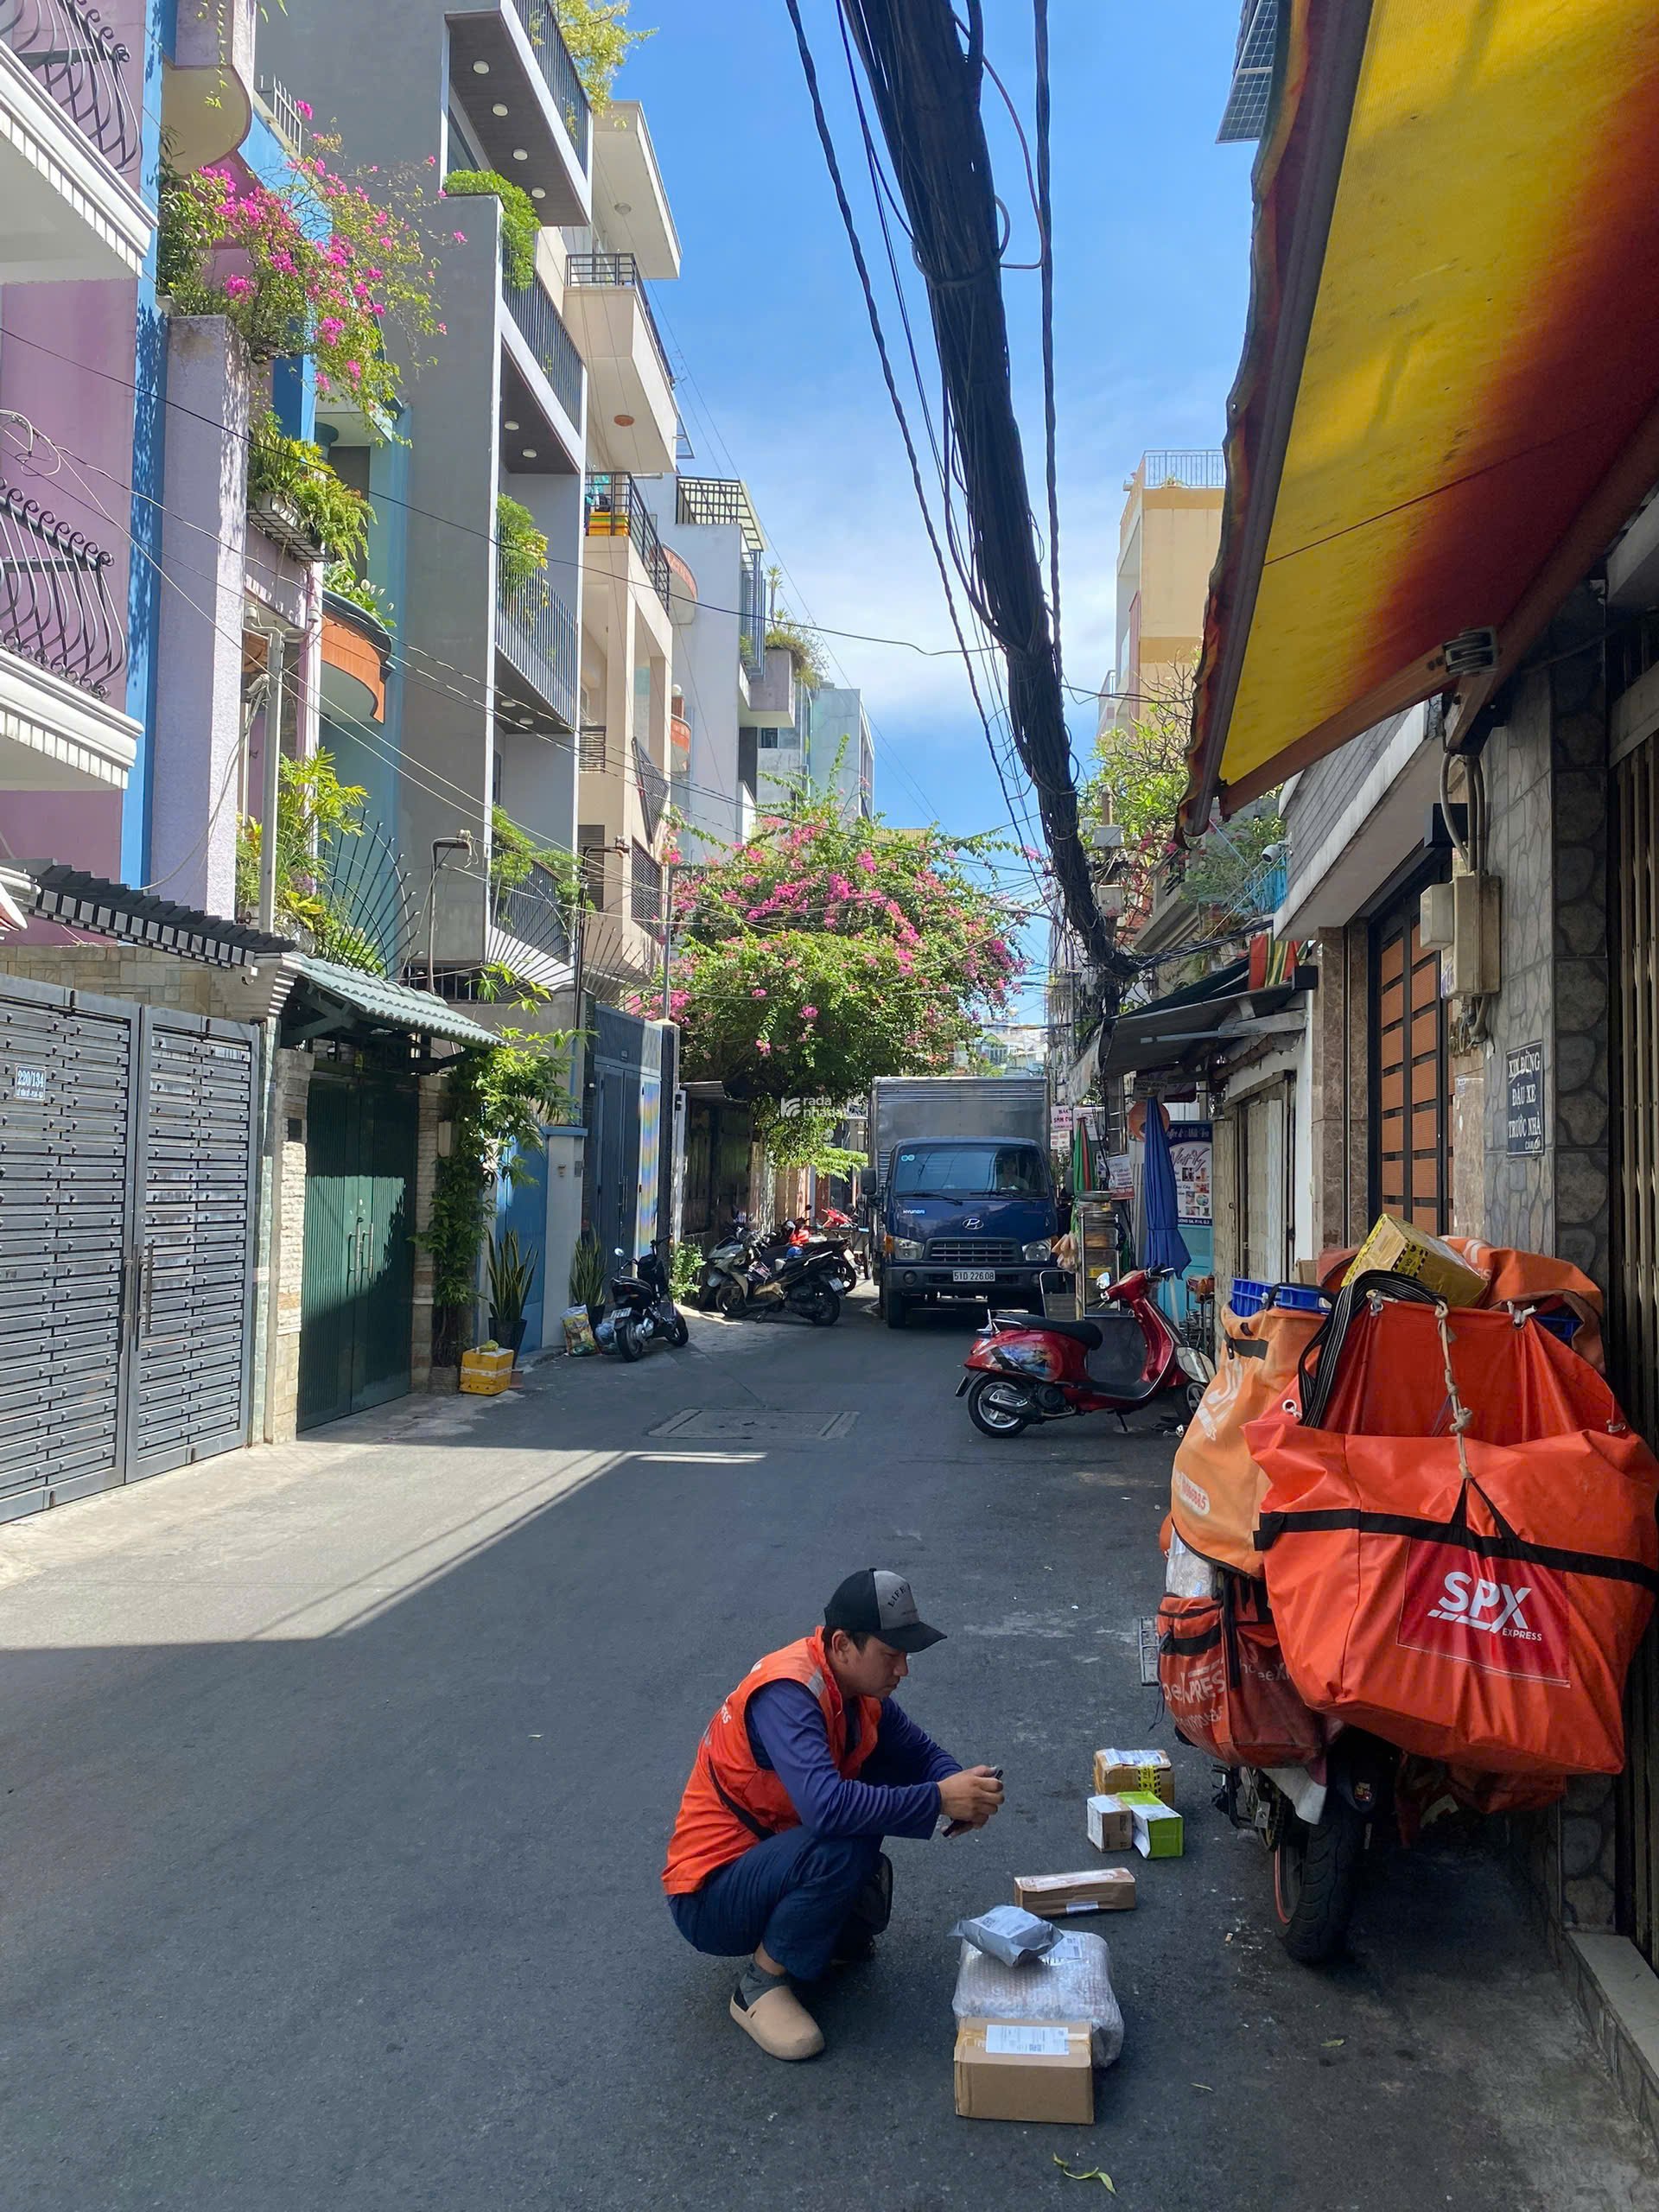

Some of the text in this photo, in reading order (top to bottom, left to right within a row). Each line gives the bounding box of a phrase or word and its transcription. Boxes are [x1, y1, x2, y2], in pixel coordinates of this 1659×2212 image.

[1526, 1084, 1536, 1103] XE
[1528, 1111, 1541, 1135] NHÀ
[887, 1585, 906, 1608] LIFE
[1438, 1571, 1532, 1634] SPX
[1502, 1627, 1542, 1642] EXPRESS
